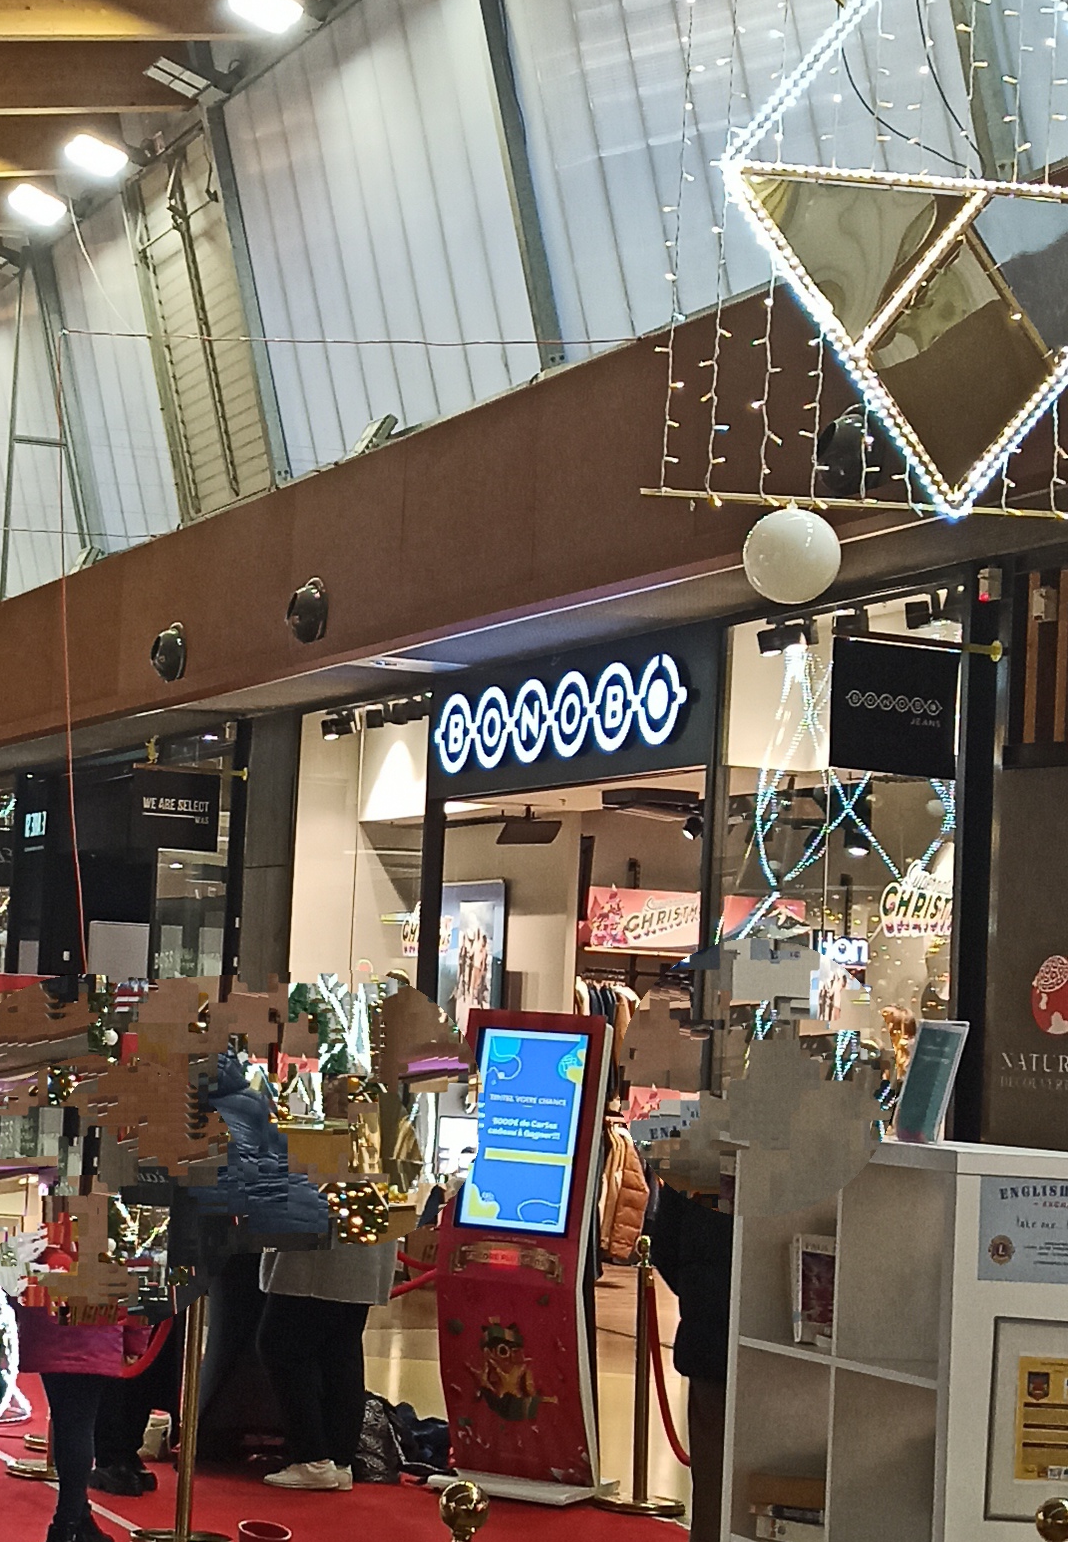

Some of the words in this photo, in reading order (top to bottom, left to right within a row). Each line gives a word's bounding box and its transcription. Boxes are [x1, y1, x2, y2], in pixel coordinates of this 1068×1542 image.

[846, 690, 943, 716] BONOBO
[435, 654, 687, 774] BONOBO
[910, 717, 941, 728] JEANS
[142, 796, 157, 810] WE
[158, 797, 176, 811] ARE
[177, 799, 209, 812] SELECT
